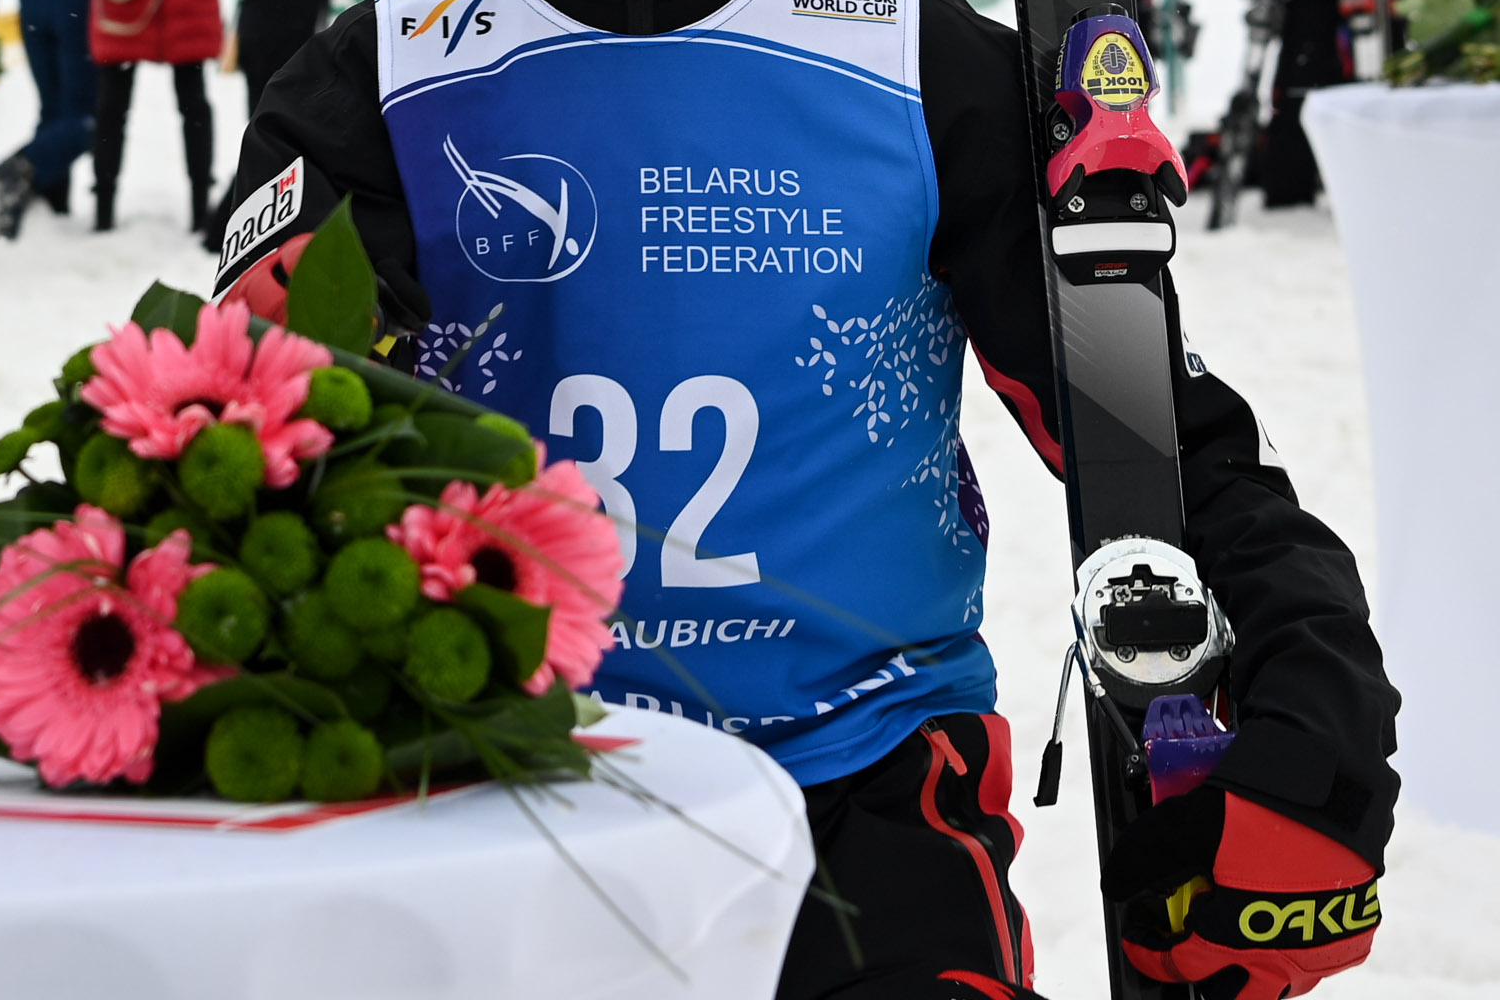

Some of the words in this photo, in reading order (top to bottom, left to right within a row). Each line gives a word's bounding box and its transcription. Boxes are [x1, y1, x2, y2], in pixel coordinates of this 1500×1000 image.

[863, 2, 897, 17] CUP
[401, 11, 496, 38] FIS
[1104, 76, 1143, 87] LOOK
[639, 166, 800, 196] BELARUS
[641, 206, 843, 236] FREESTYLE
[641, 246, 863, 274] FEDERATION
[548, 374, 761, 588] 32
[599, 618, 796, 650] AUBICHI
